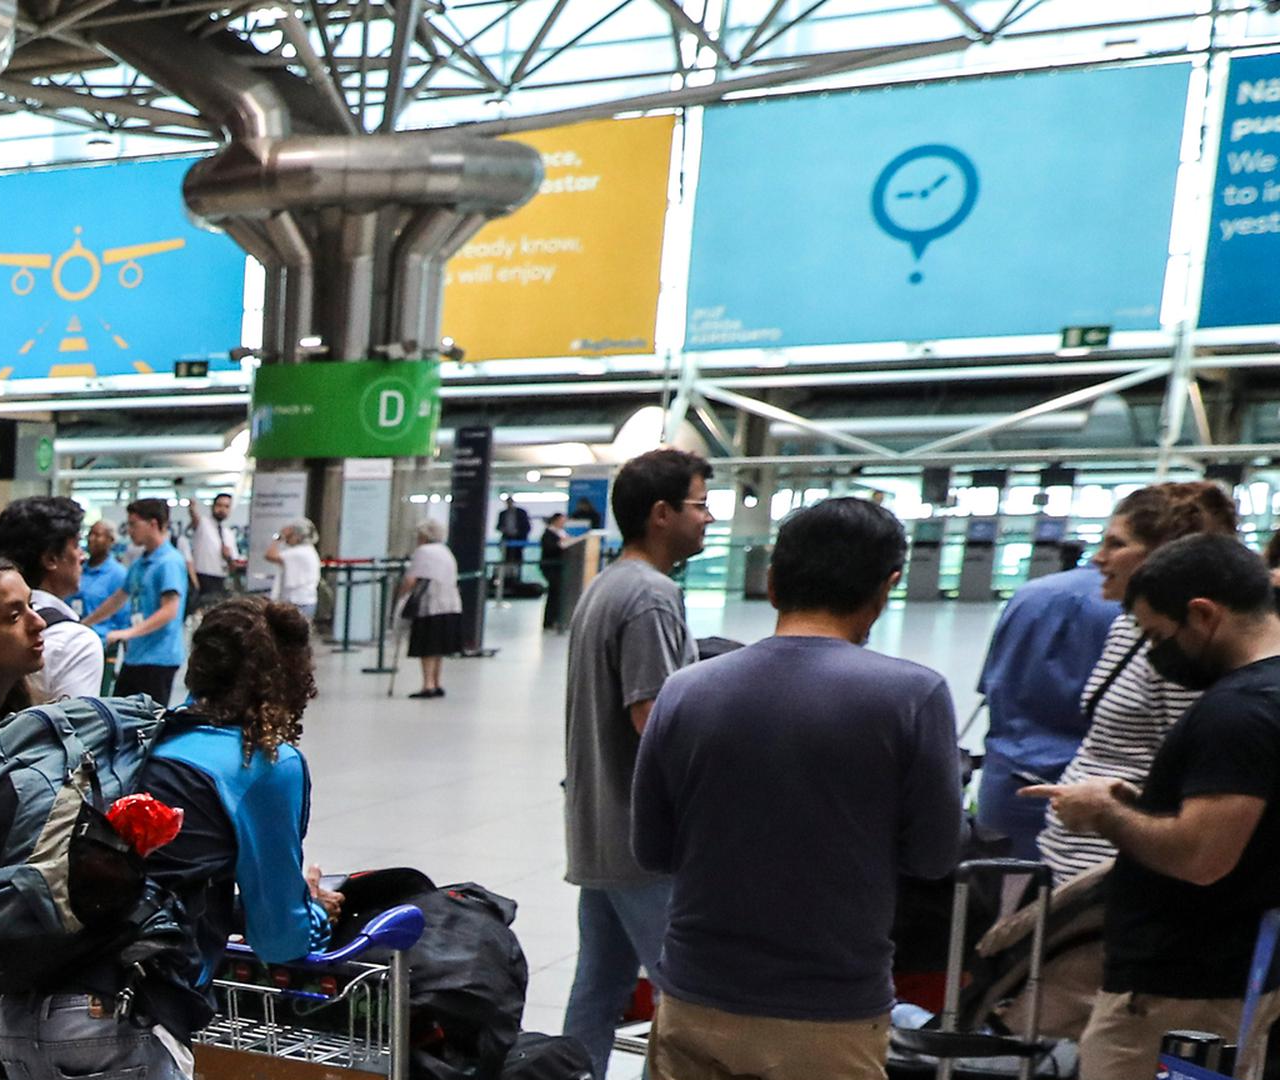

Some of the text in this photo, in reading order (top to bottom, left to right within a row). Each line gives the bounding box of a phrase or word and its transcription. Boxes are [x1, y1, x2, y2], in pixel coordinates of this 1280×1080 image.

[1227, 148, 1277, 175] We
[1224, 184, 1258, 207] to
[378, 389, 405, 428] D
